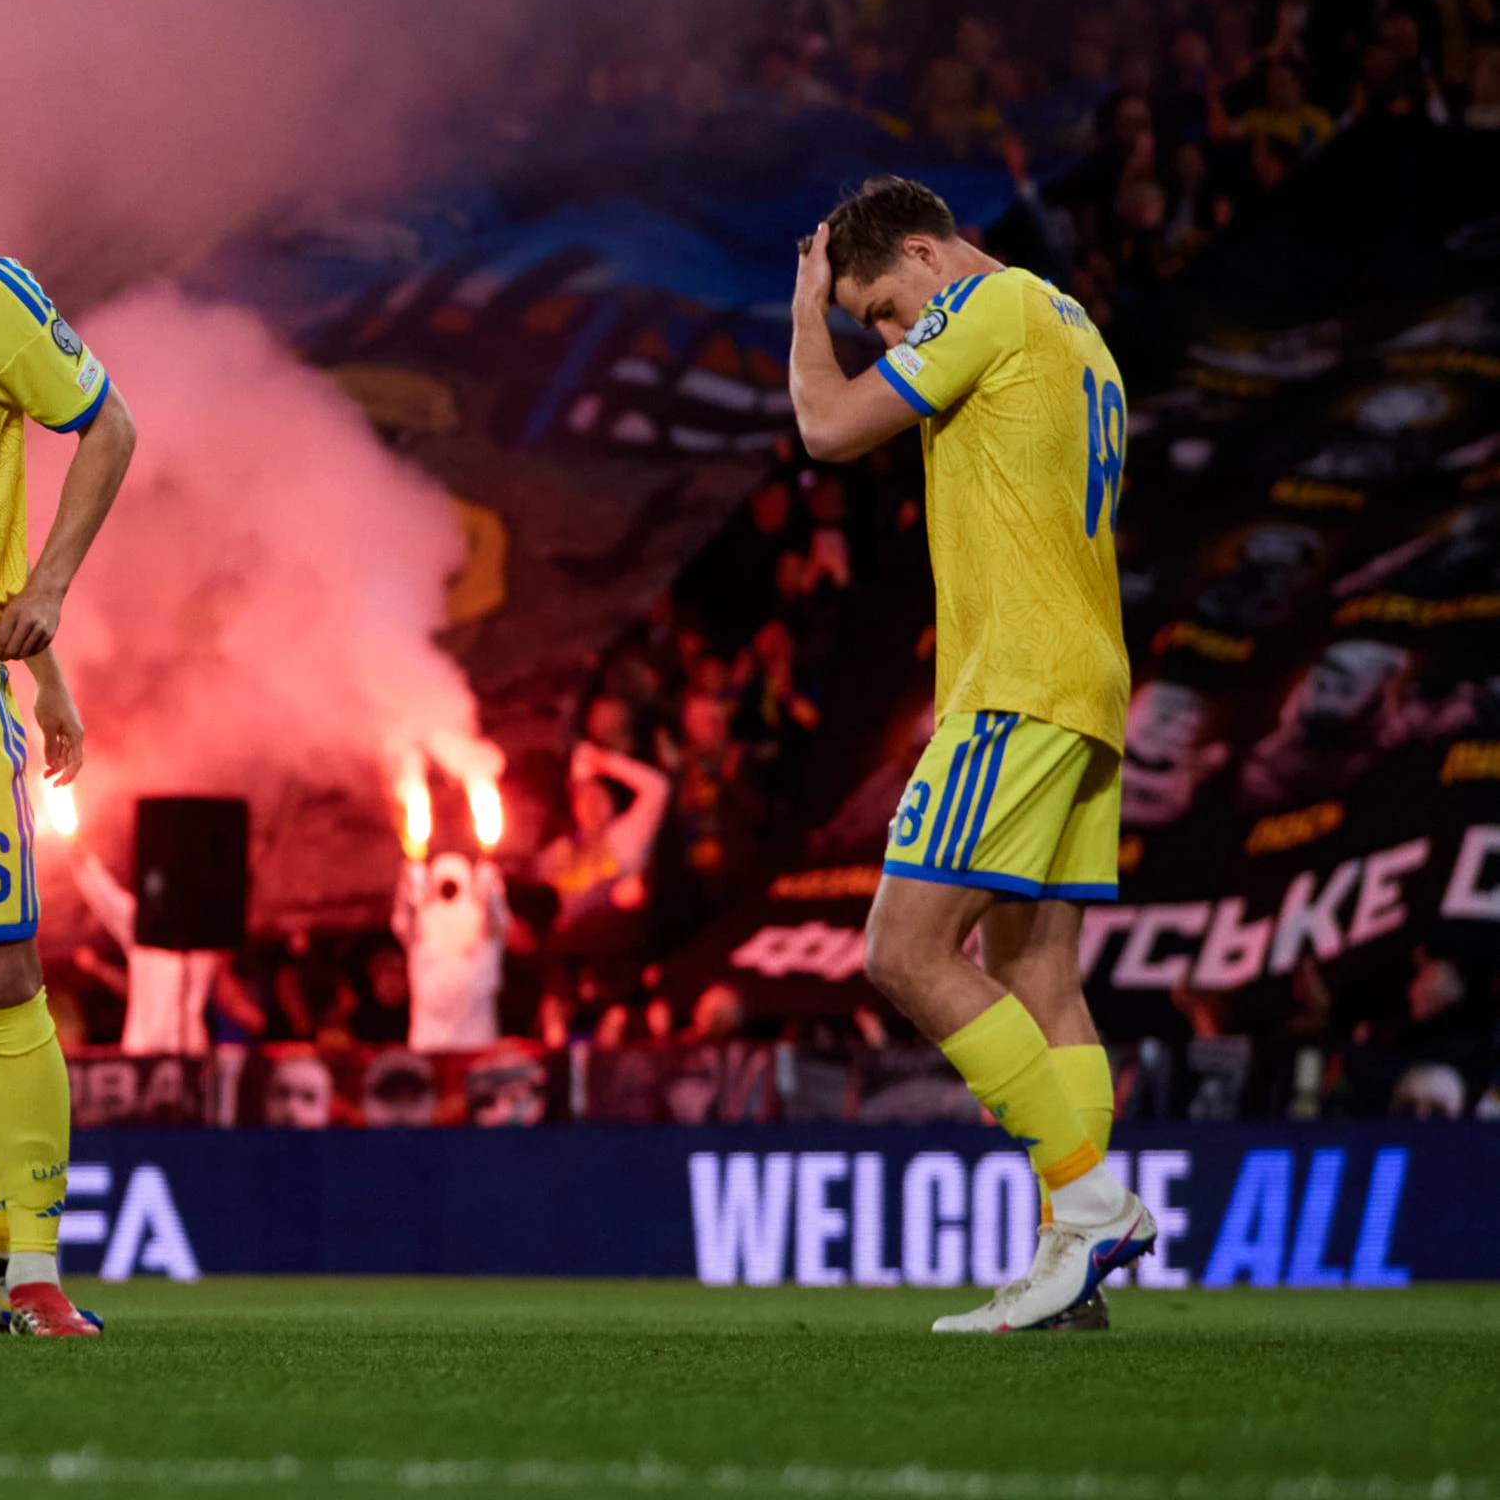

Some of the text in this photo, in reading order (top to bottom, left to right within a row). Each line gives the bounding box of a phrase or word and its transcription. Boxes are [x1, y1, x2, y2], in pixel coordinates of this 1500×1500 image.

[889, 780, 932, 848] 8
[1080, 836, 1431, 990] ТСЬКЕ
[687, 1147, 1411, 1290] WELCOE ALL
